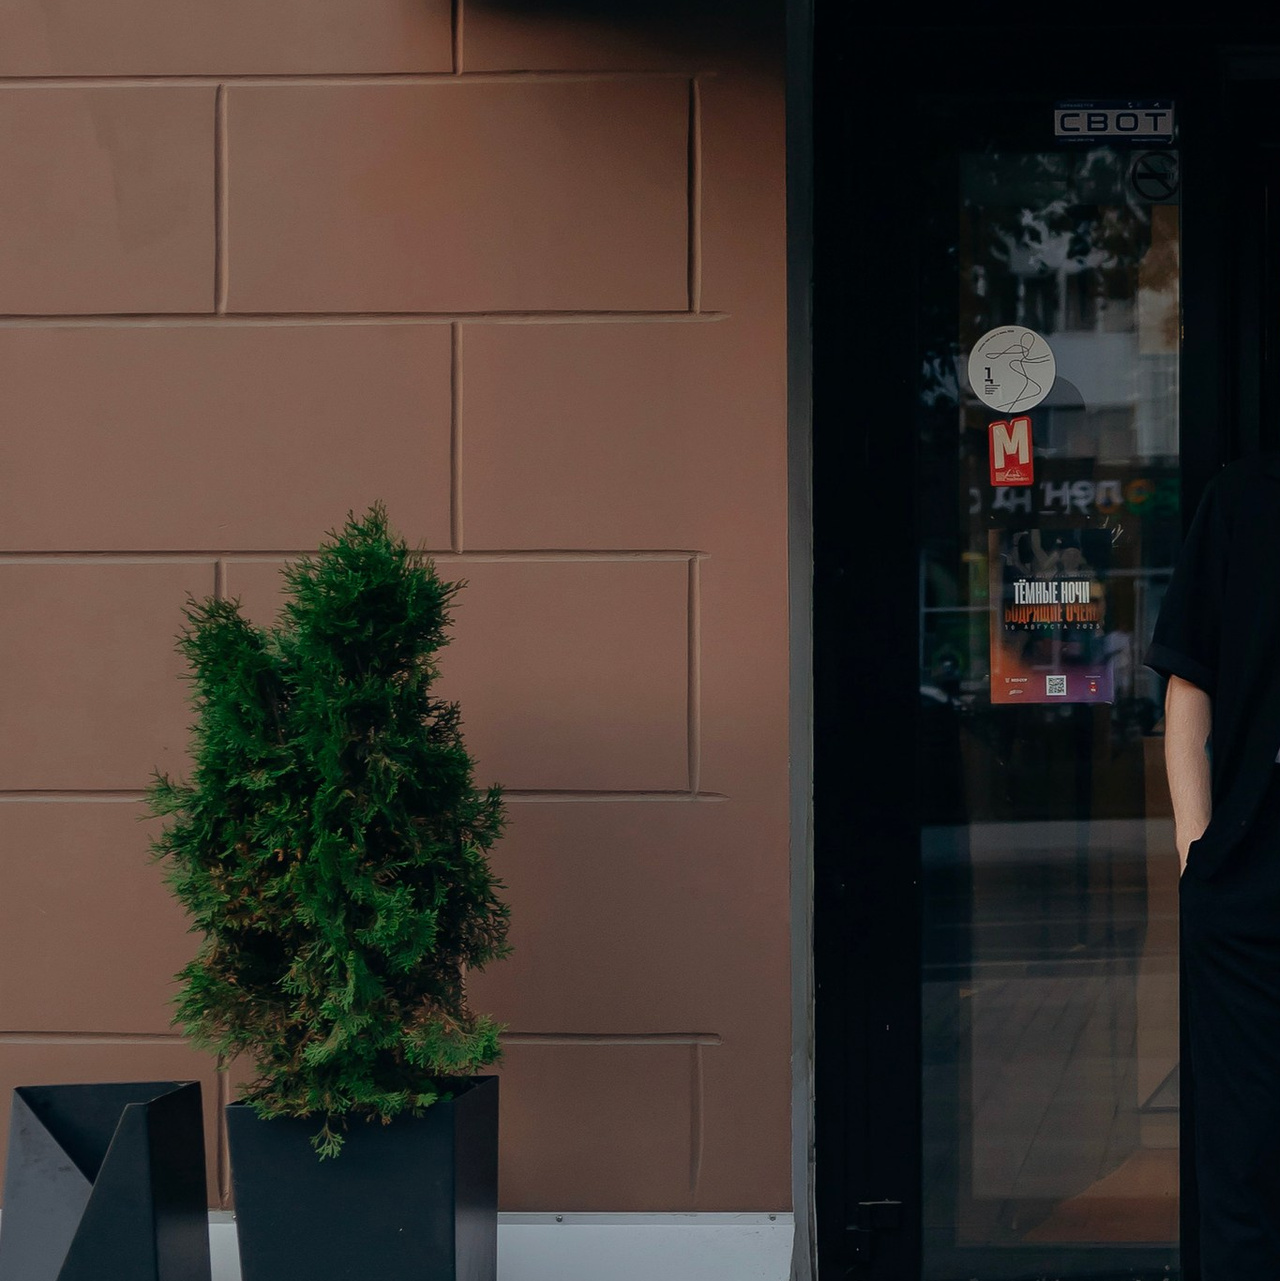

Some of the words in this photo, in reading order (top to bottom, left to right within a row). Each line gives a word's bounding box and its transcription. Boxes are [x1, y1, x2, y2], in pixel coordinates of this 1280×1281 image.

[1060, 112, 1167, 132] СВОТ
[1013, 578, 1059, 604] ТЁМНЫЕ
[1060, 581, 1090, 604] НОЧИ
